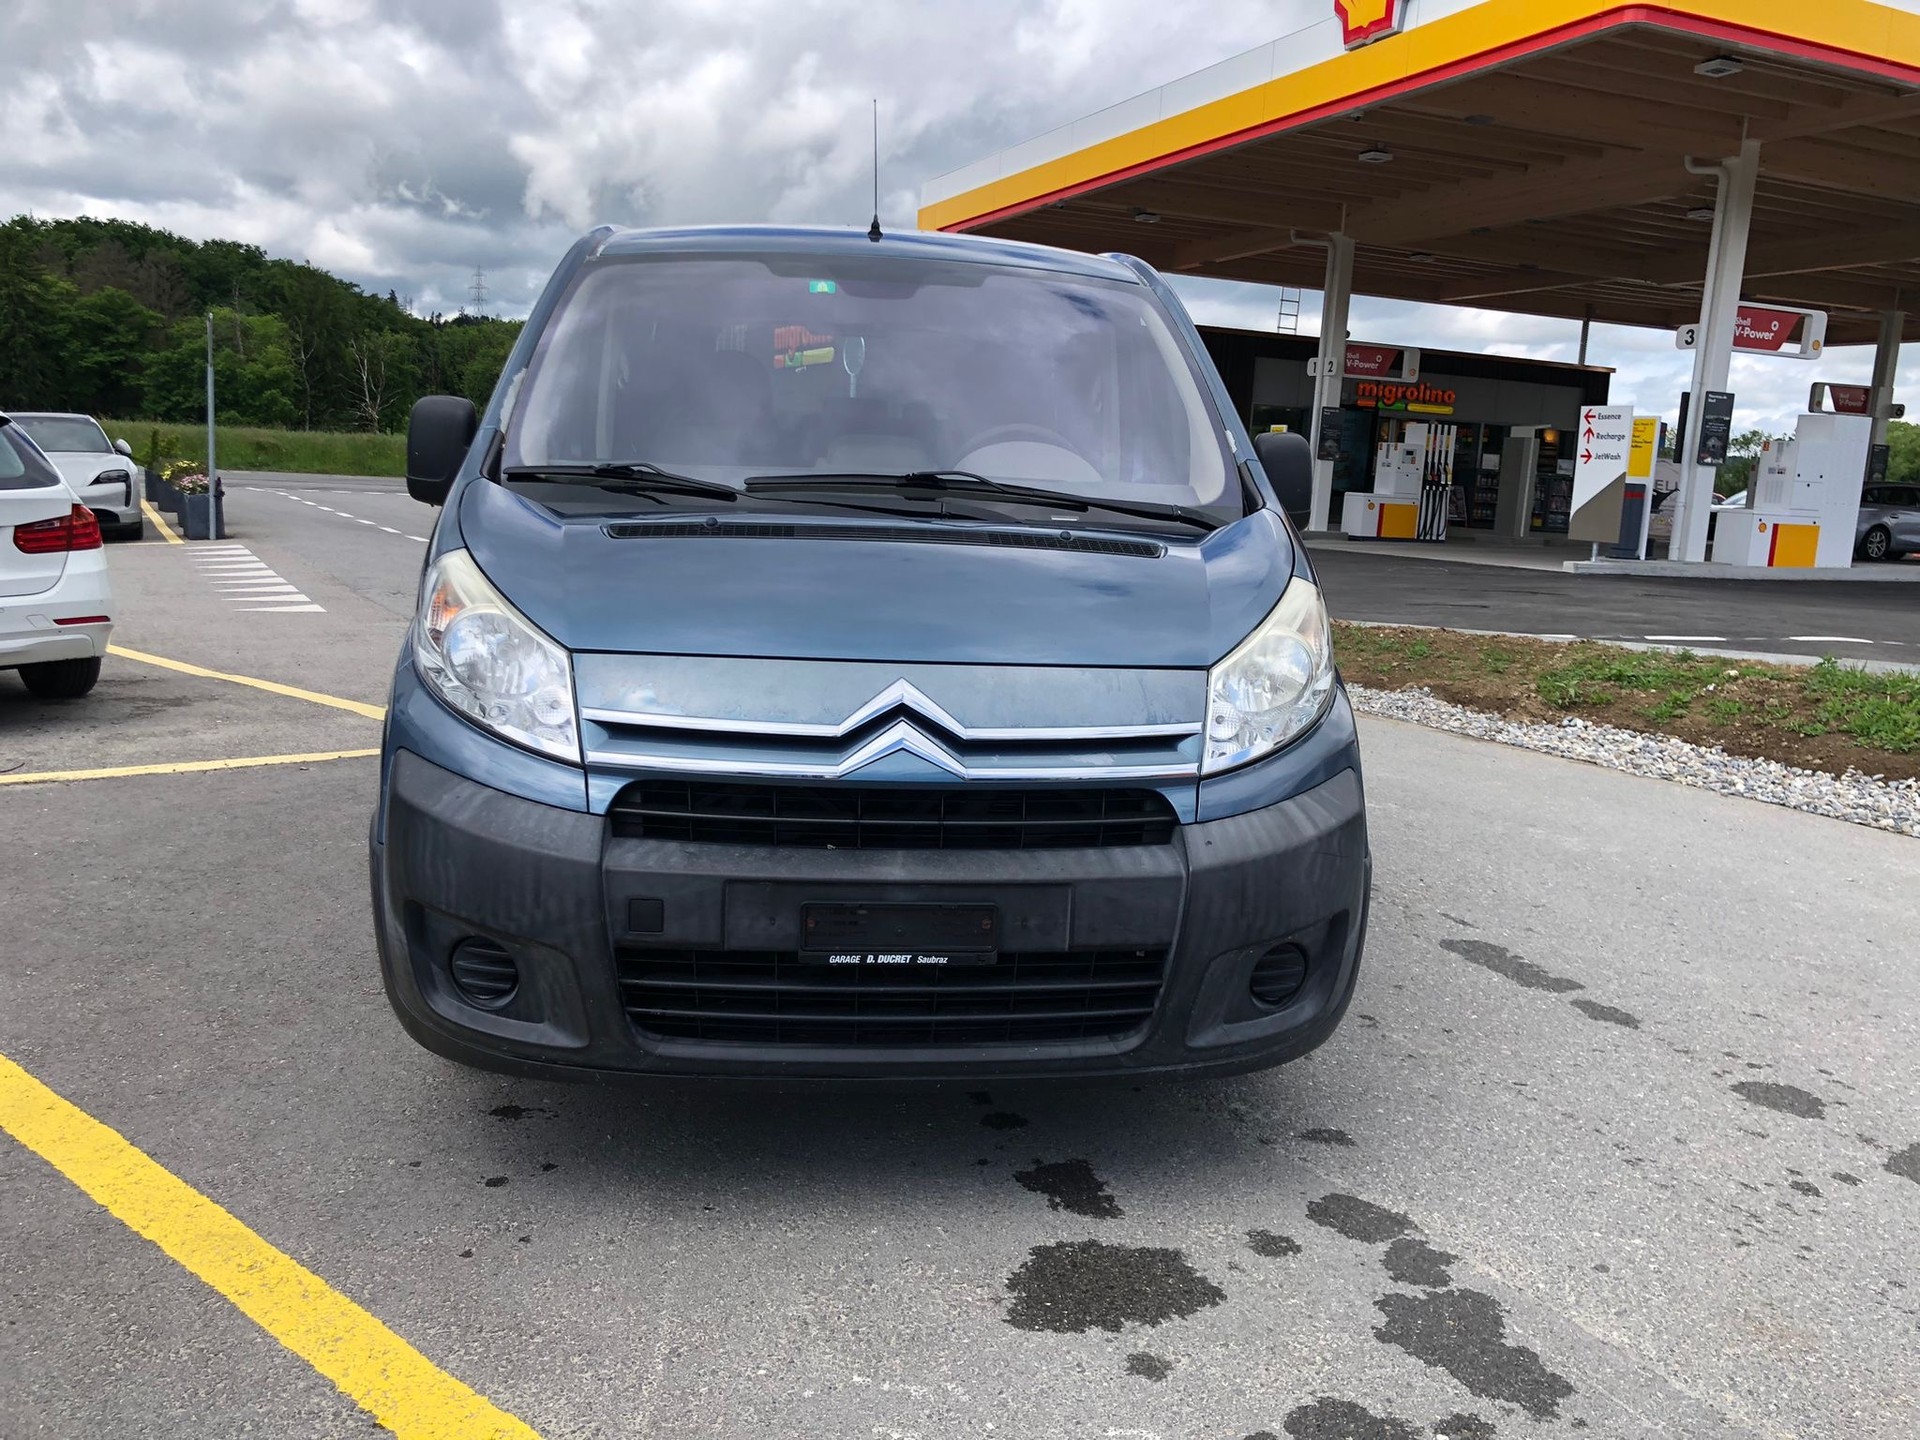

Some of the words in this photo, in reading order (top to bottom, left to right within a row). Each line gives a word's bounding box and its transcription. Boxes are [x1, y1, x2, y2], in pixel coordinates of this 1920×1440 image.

[1735, 316, 1751, 326] Shell
[1684, 329, 1695, 345] 3
[1734, 326, 1774, 341] V-Power
[1327, 360, 1334, 373] 2
[1346, 359, 1379, 370] V-Power
[1357, 382, 1456, 405] migrolino
[1597, 413, 1622, 421] Essence
[1596, 432, 1626, 442] Recharge
[1594, 452, 1621, 461] JetWash
[829, 955, 861, 964] GARAGE
[866, 954, 875, 964] D.
[877, 954, 912, 964] DUCRET
[917, 955, 948, 964] Saubraz
